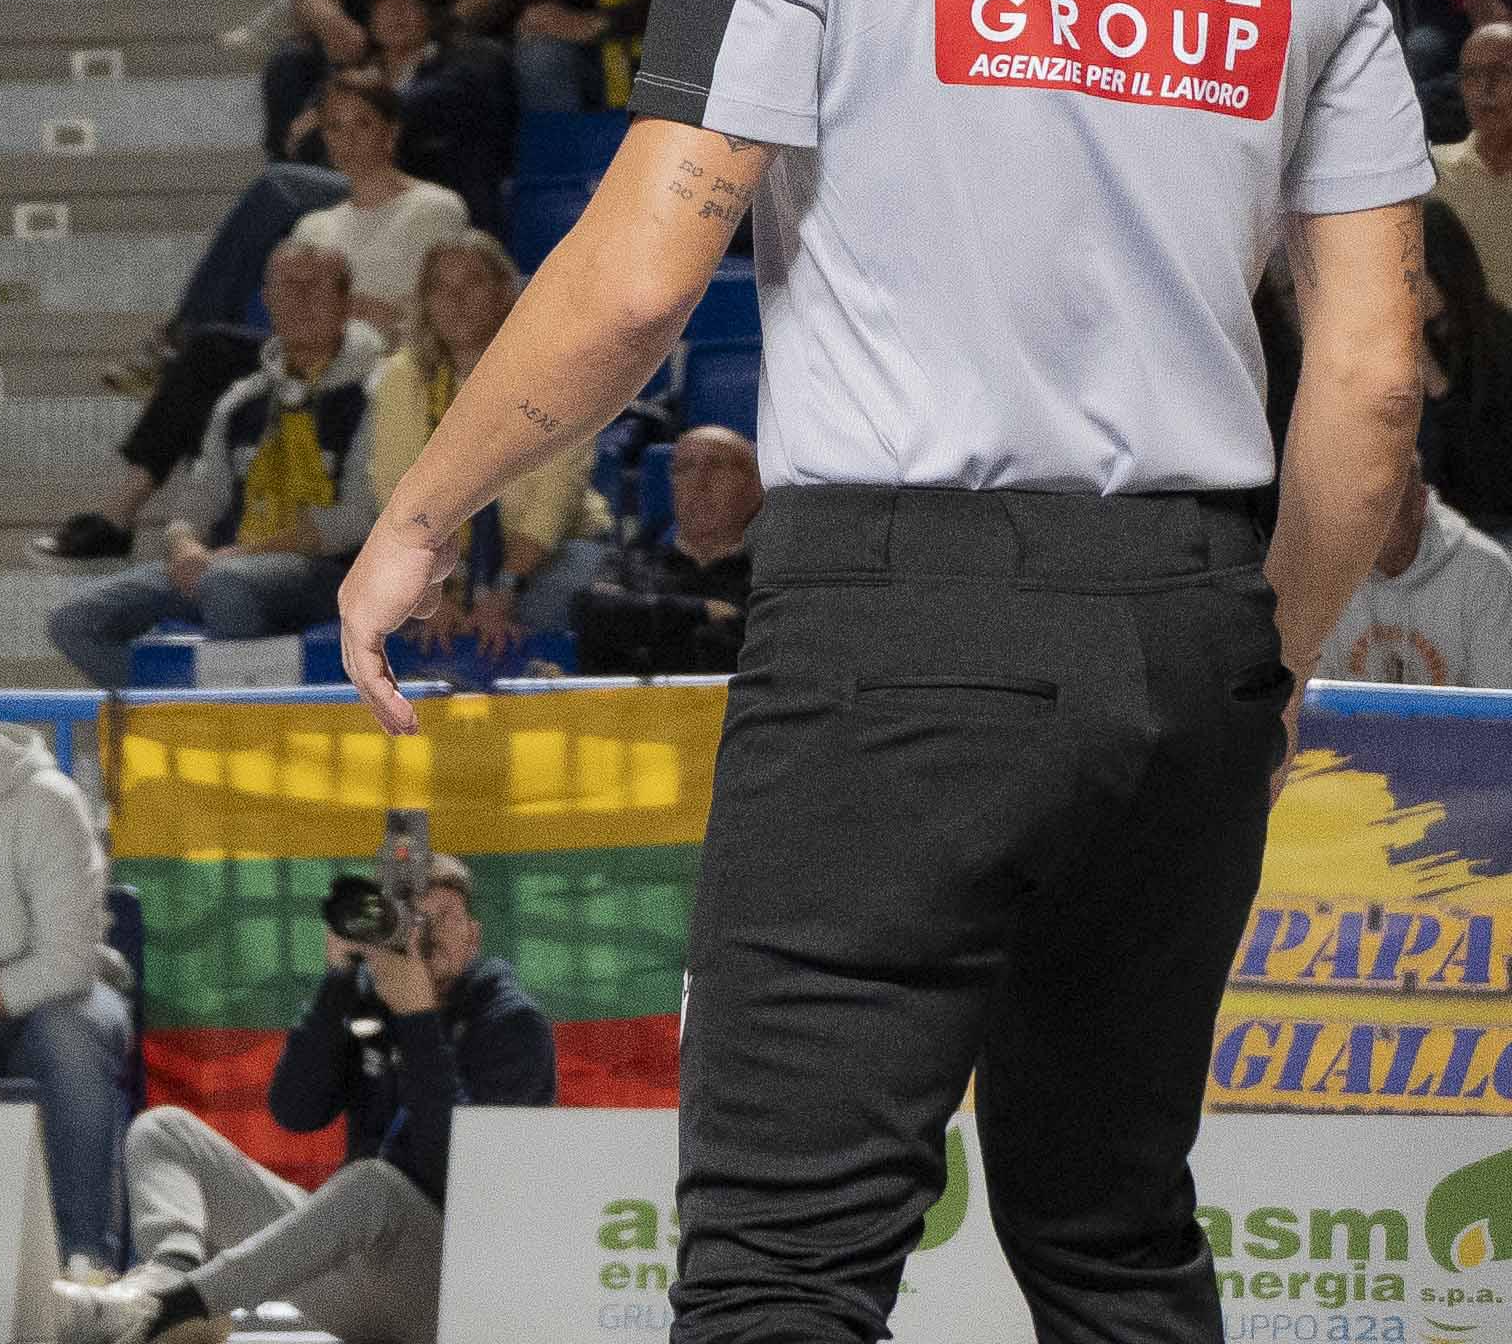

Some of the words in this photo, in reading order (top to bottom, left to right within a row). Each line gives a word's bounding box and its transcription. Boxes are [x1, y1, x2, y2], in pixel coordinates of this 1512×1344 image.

[968, 53, 1082, 84] AGENZIE
[1085, 66, 1125, 93] PER
[1131, 71, 1152, 96] IL
[1160, 74, 1249, 110] LAVORO
[1215, 1262, 1406, 1311] nergia
[1327, 1314, 1407, 1343] a2a
